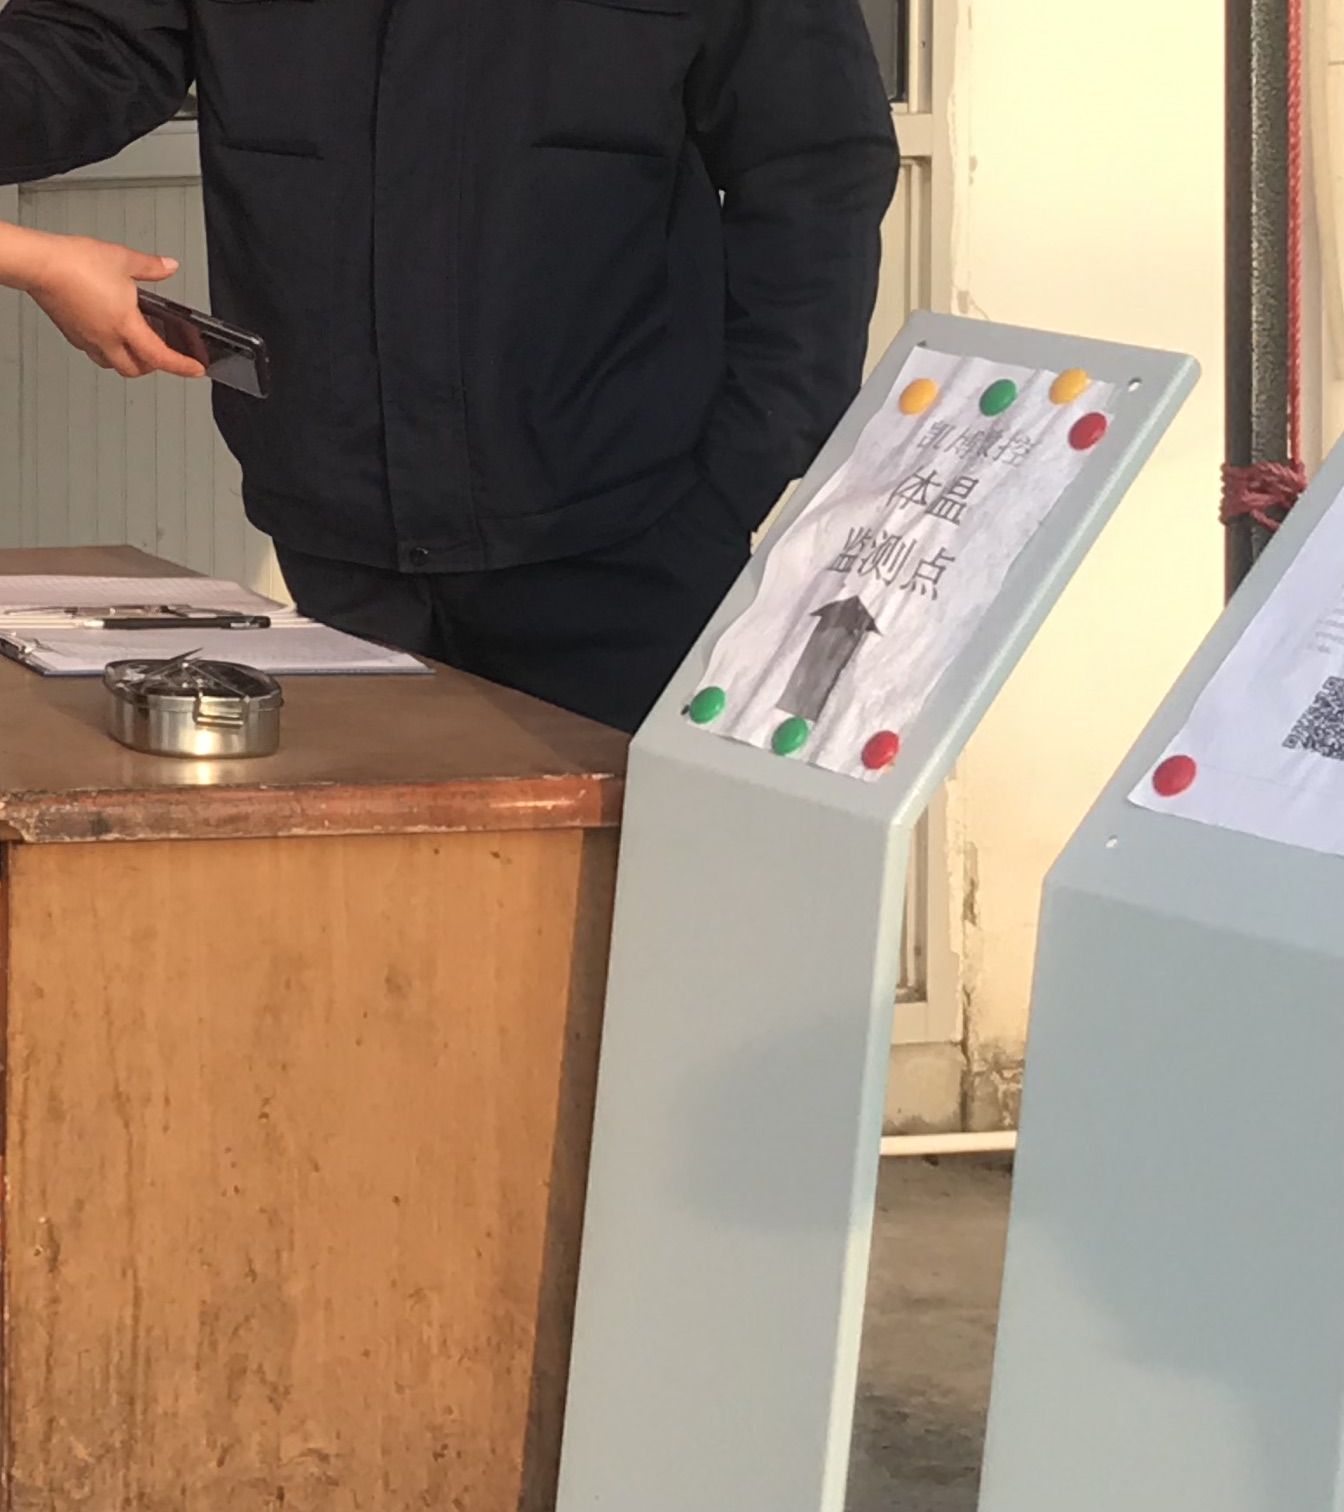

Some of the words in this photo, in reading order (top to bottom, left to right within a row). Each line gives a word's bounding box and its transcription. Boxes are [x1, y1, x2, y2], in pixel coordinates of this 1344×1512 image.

[886, 467, 980, 525] 体温
[827, 525, 956, 601] 监测点
